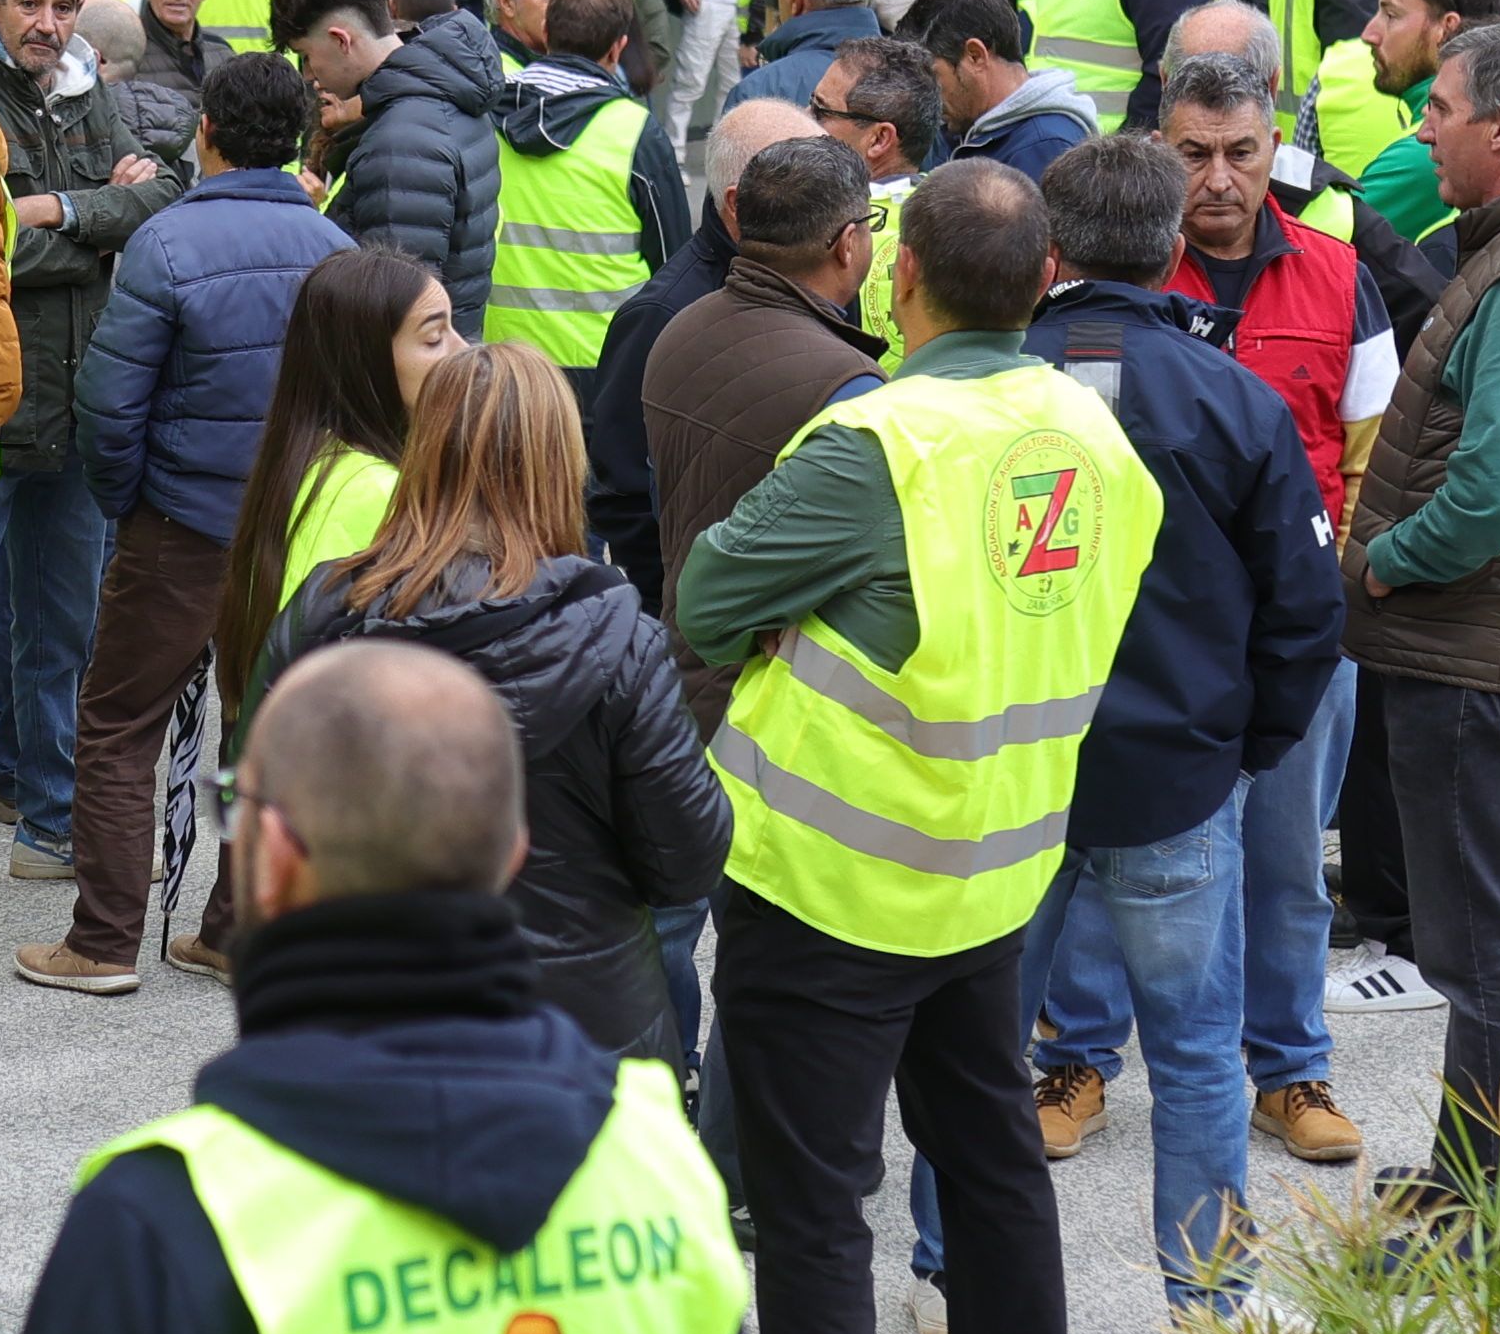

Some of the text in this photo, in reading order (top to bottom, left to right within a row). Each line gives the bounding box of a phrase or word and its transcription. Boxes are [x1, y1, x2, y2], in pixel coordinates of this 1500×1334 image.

[1047, 278, 1085, 299] HELL
[999, 434, 1062, 478] AGRICULTORES
[990, 479, 1004, 497] DE
[987, 498, 1009, 578] ASOCIACIÓN
